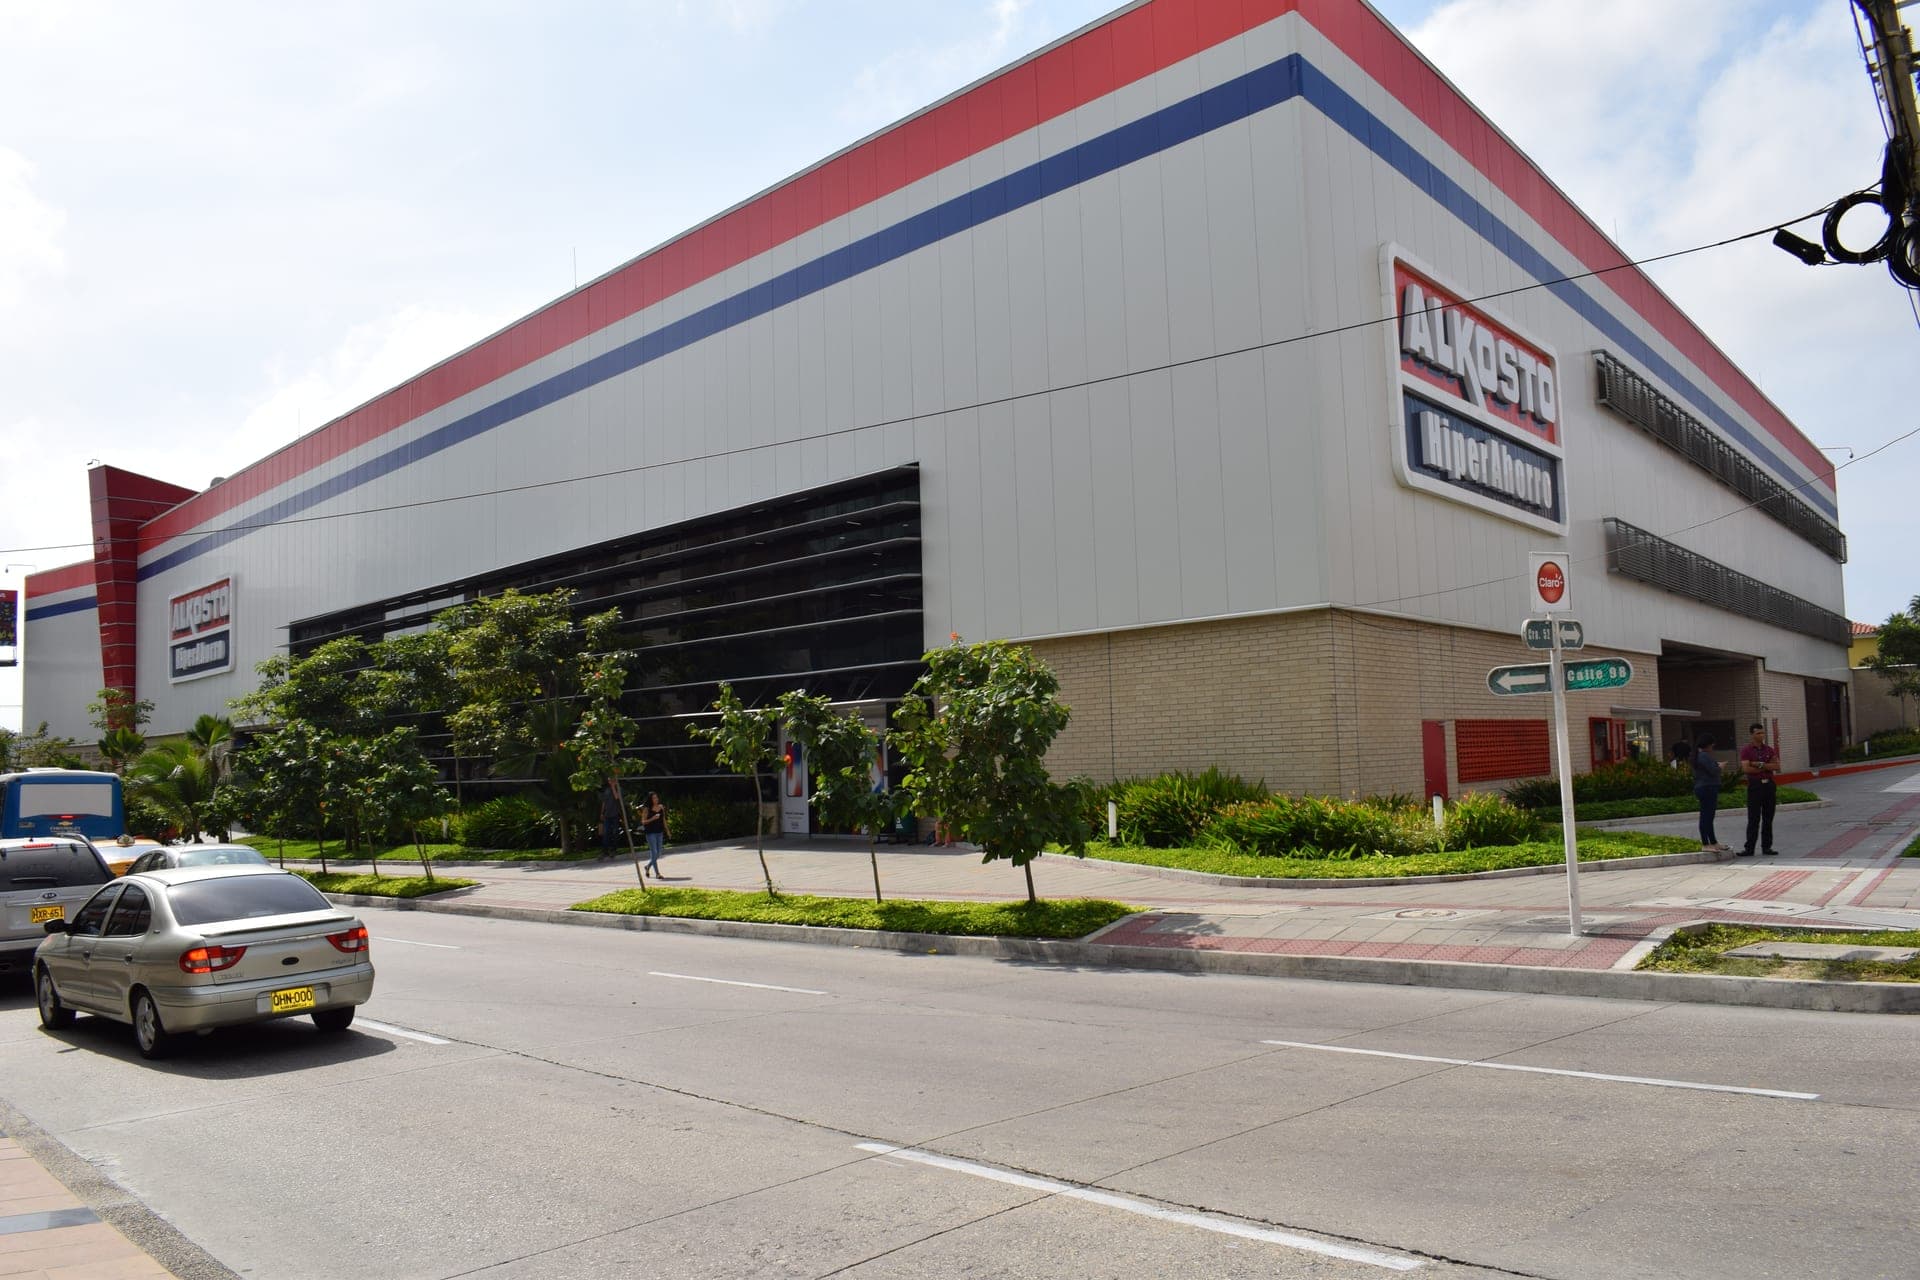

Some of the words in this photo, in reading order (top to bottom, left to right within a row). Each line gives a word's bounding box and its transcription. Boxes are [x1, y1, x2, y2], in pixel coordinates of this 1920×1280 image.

[1402, 284, 1556, 424] ALKOSTO
[1419, 410, 1552, 508] HiperAhorro
[1539, 577, 1560, 588] Claro
[173, 585, 229, 633] ALKOSTO
[1567, 668, 1603, 682] Calle
[1609, 666, 1627, 679] 98
